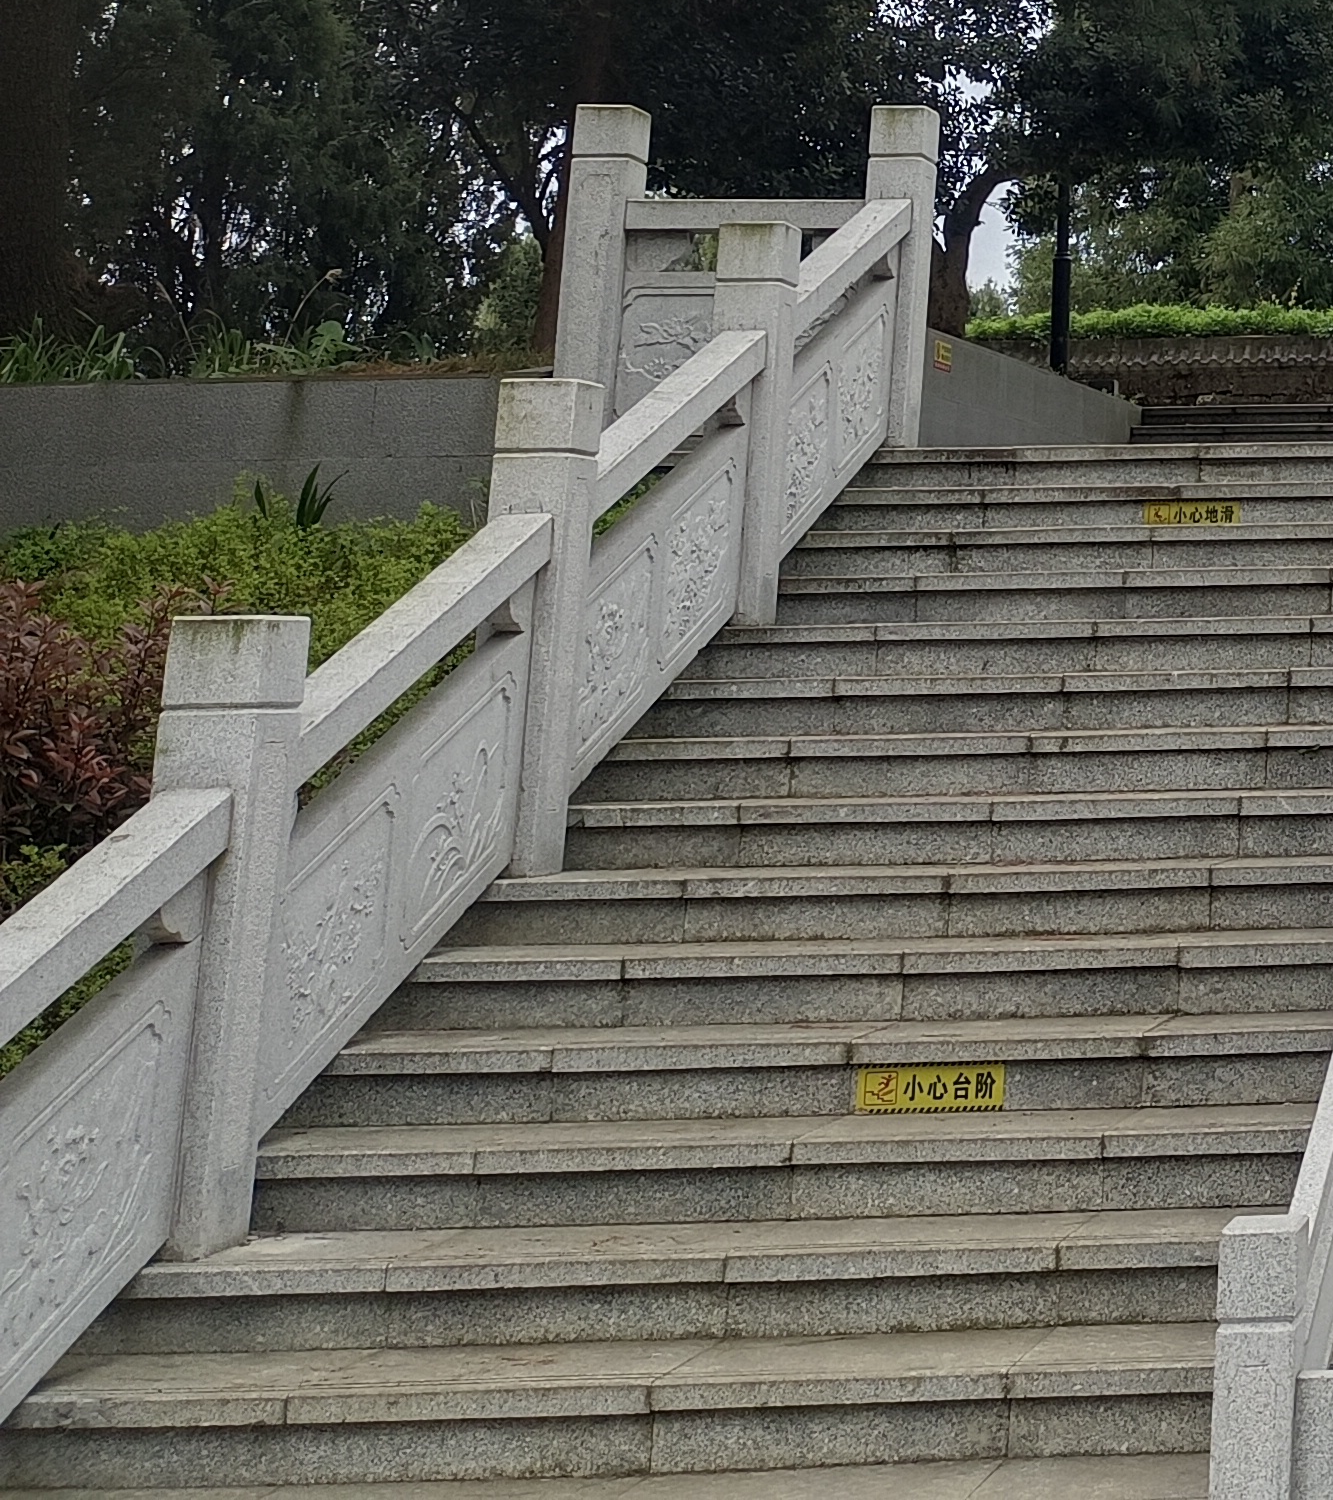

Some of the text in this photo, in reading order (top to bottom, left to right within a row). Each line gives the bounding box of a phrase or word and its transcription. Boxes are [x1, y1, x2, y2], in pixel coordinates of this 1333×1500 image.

[1173, 505, 1235, 524] 小心地滑
[903, 1071, 996, 1102] 小心台阶
